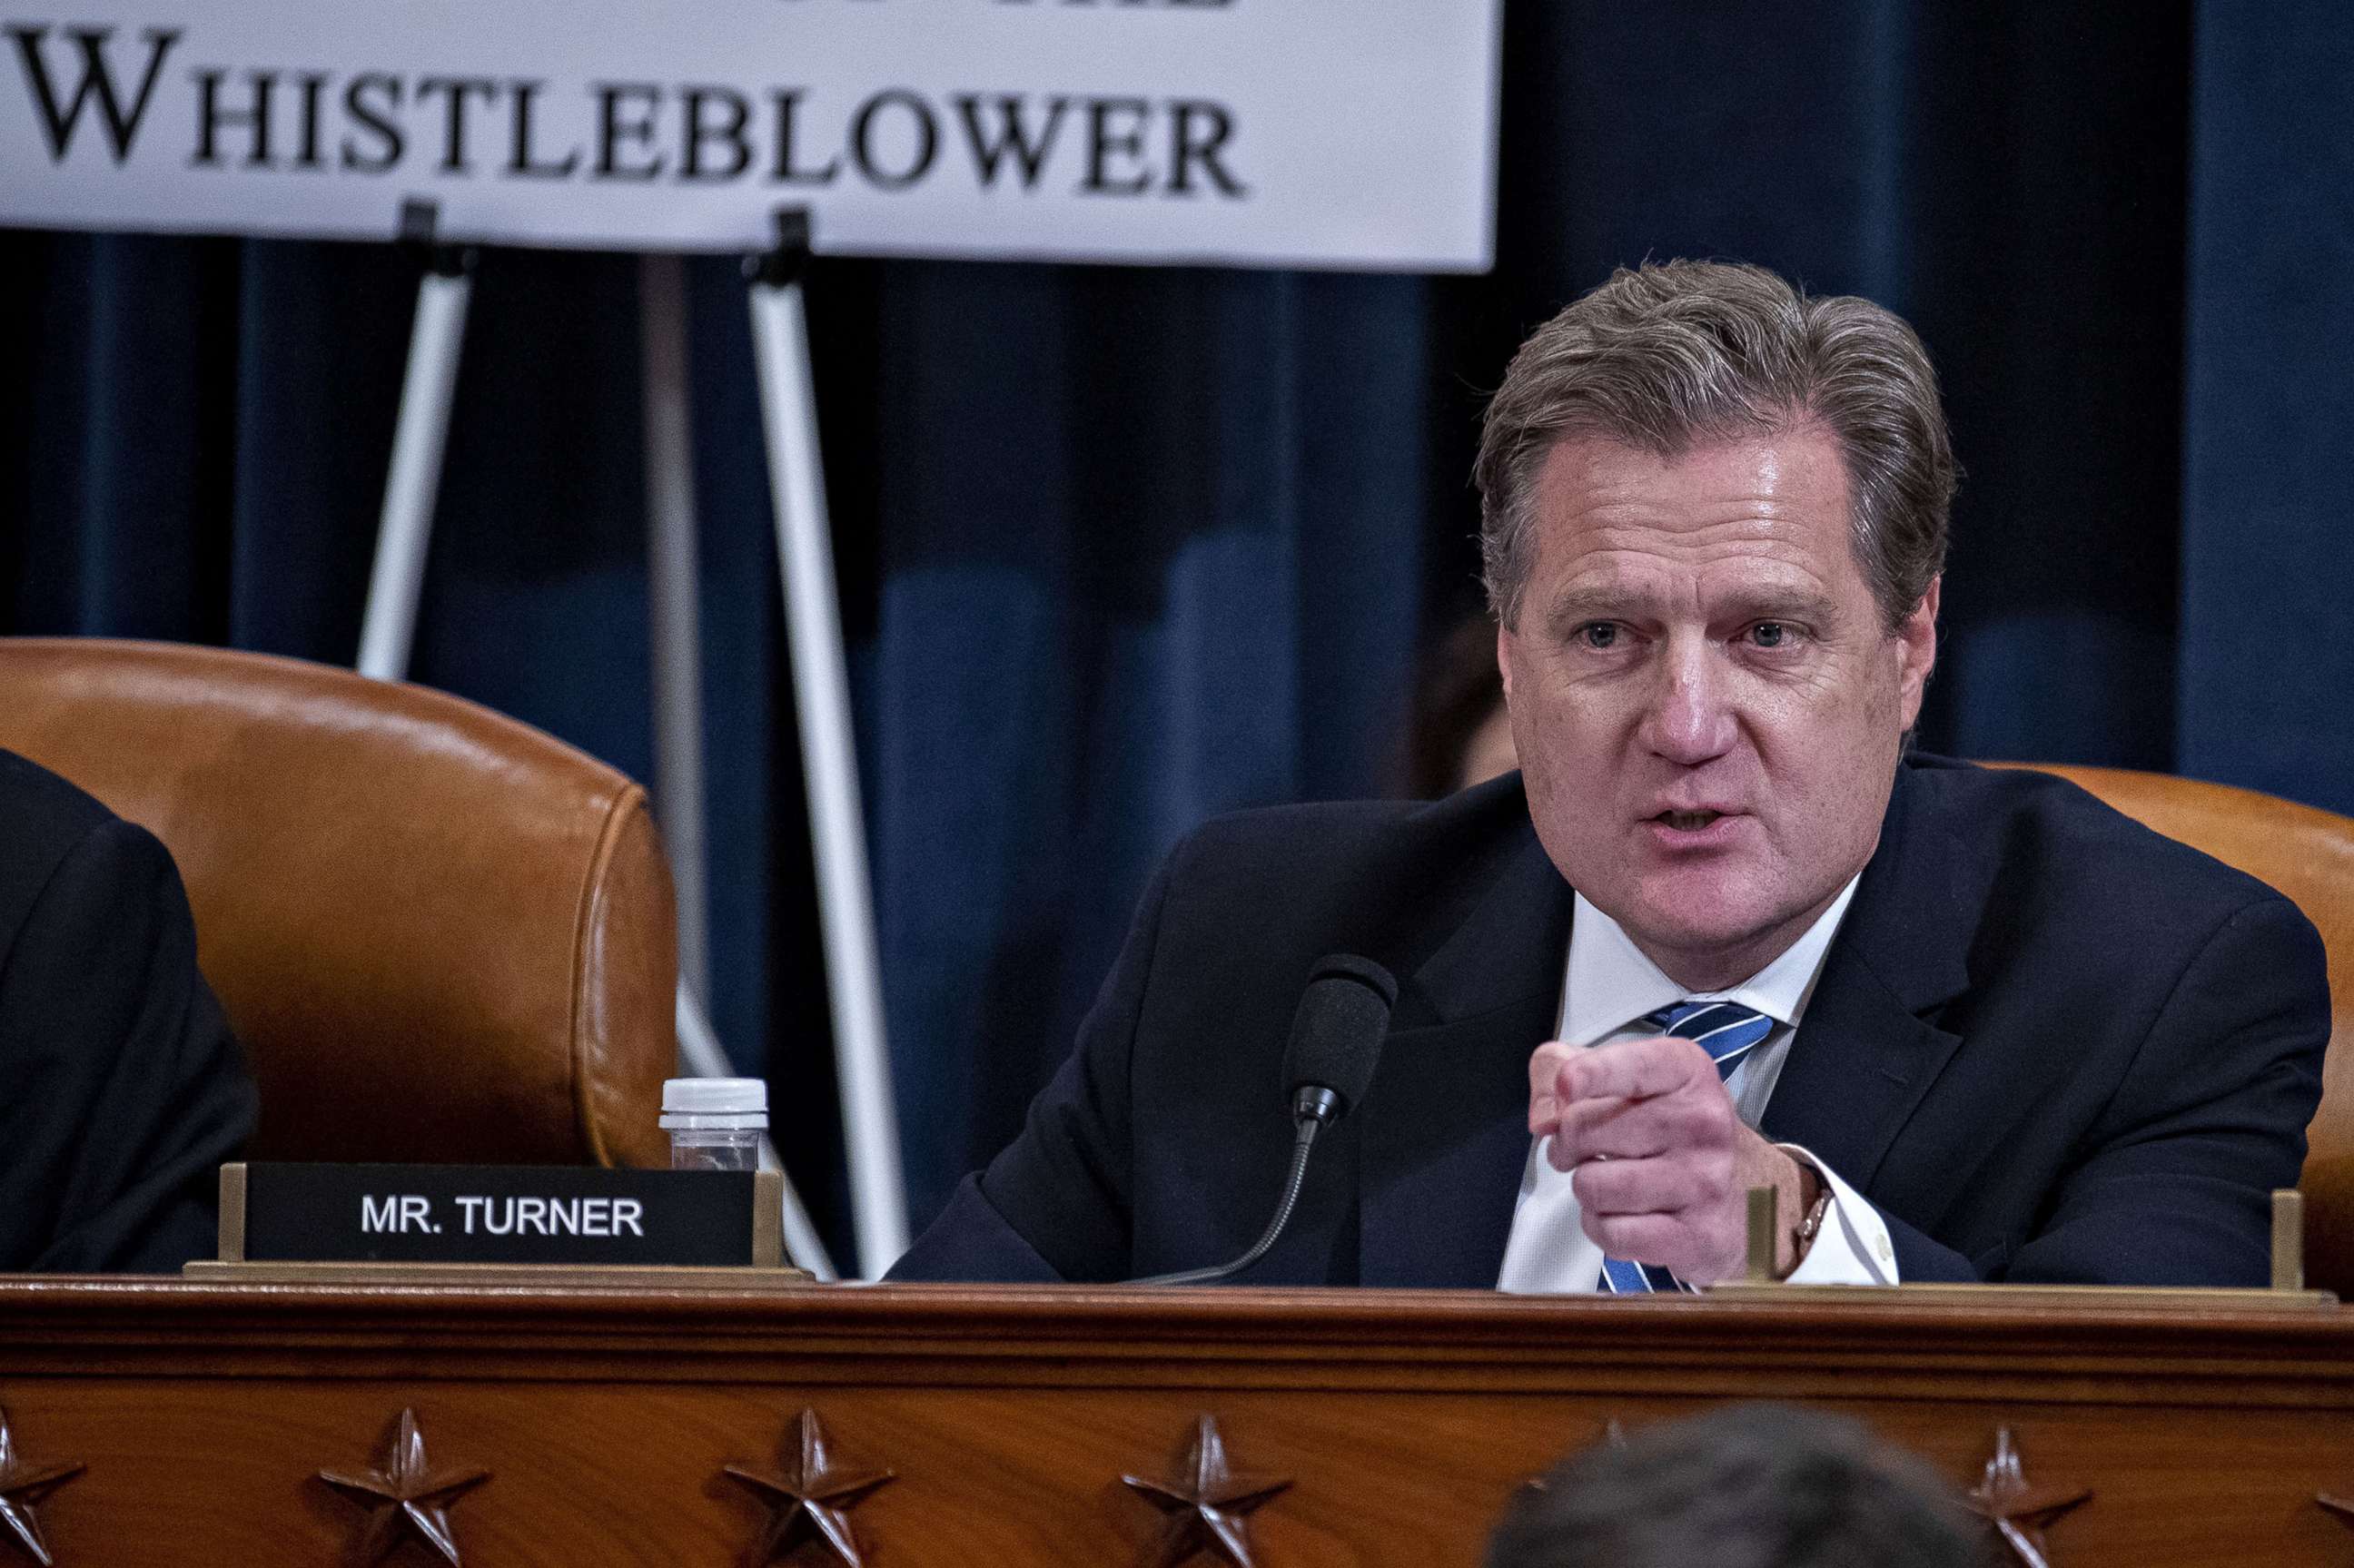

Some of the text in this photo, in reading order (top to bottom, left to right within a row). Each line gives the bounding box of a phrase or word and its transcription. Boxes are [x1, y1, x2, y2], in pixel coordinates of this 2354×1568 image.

[3, 25, 1247, 199] WHISTLEBLOWER
[361, 1196, 644, 1237] MR. TURNER
